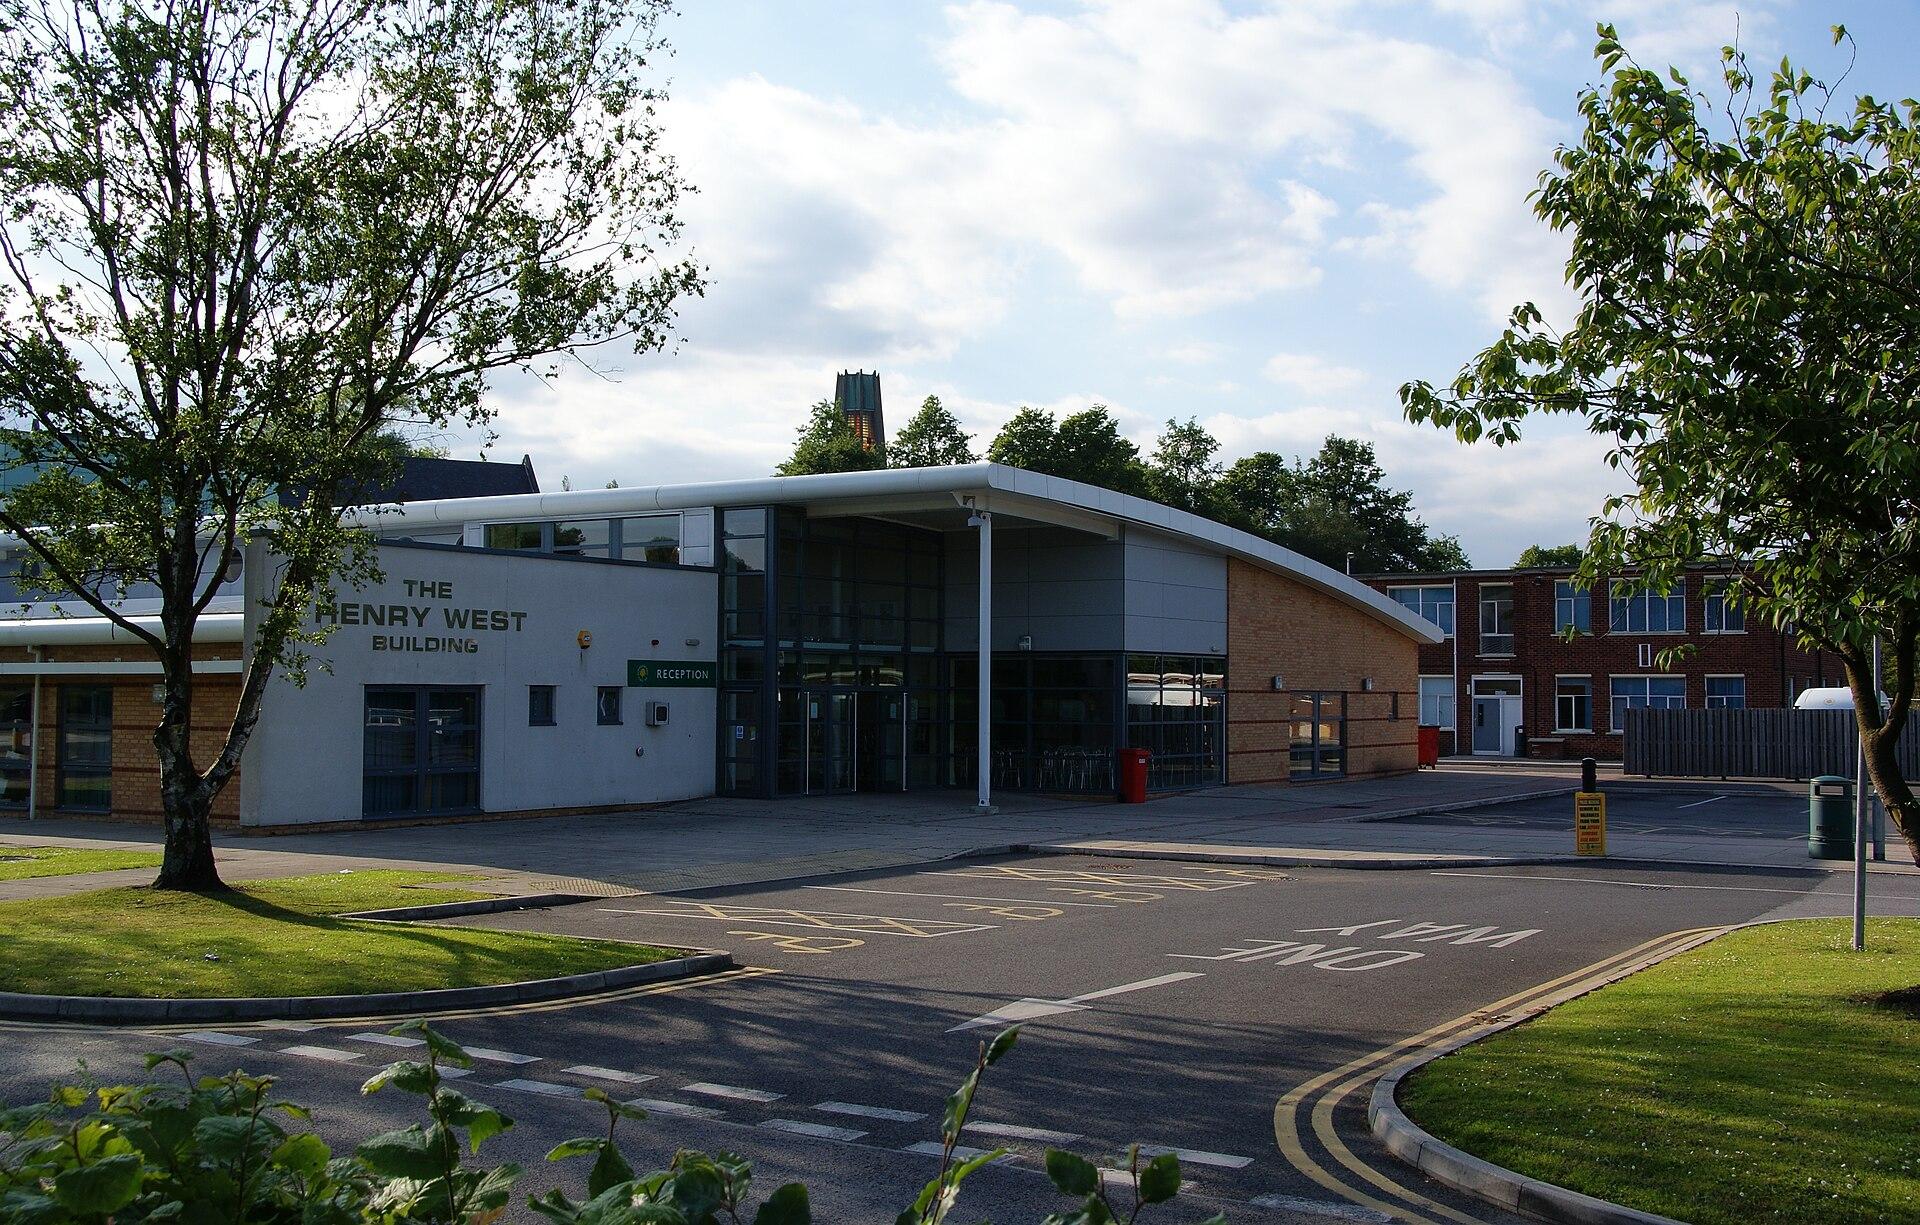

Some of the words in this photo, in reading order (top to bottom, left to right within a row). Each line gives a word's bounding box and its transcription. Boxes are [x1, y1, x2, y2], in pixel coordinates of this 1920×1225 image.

[403, 579, 453, 599] THE
[315, 602, 431, 628] HENRY
[443, 608, 528, 632] WEST
[372, 635, 479, 654] BUILDING
[656, 669, 709, 680] RECEPTION
[1294, 919, 1544, 948] WAY
[1166, 938, 1426, 971] ONE
